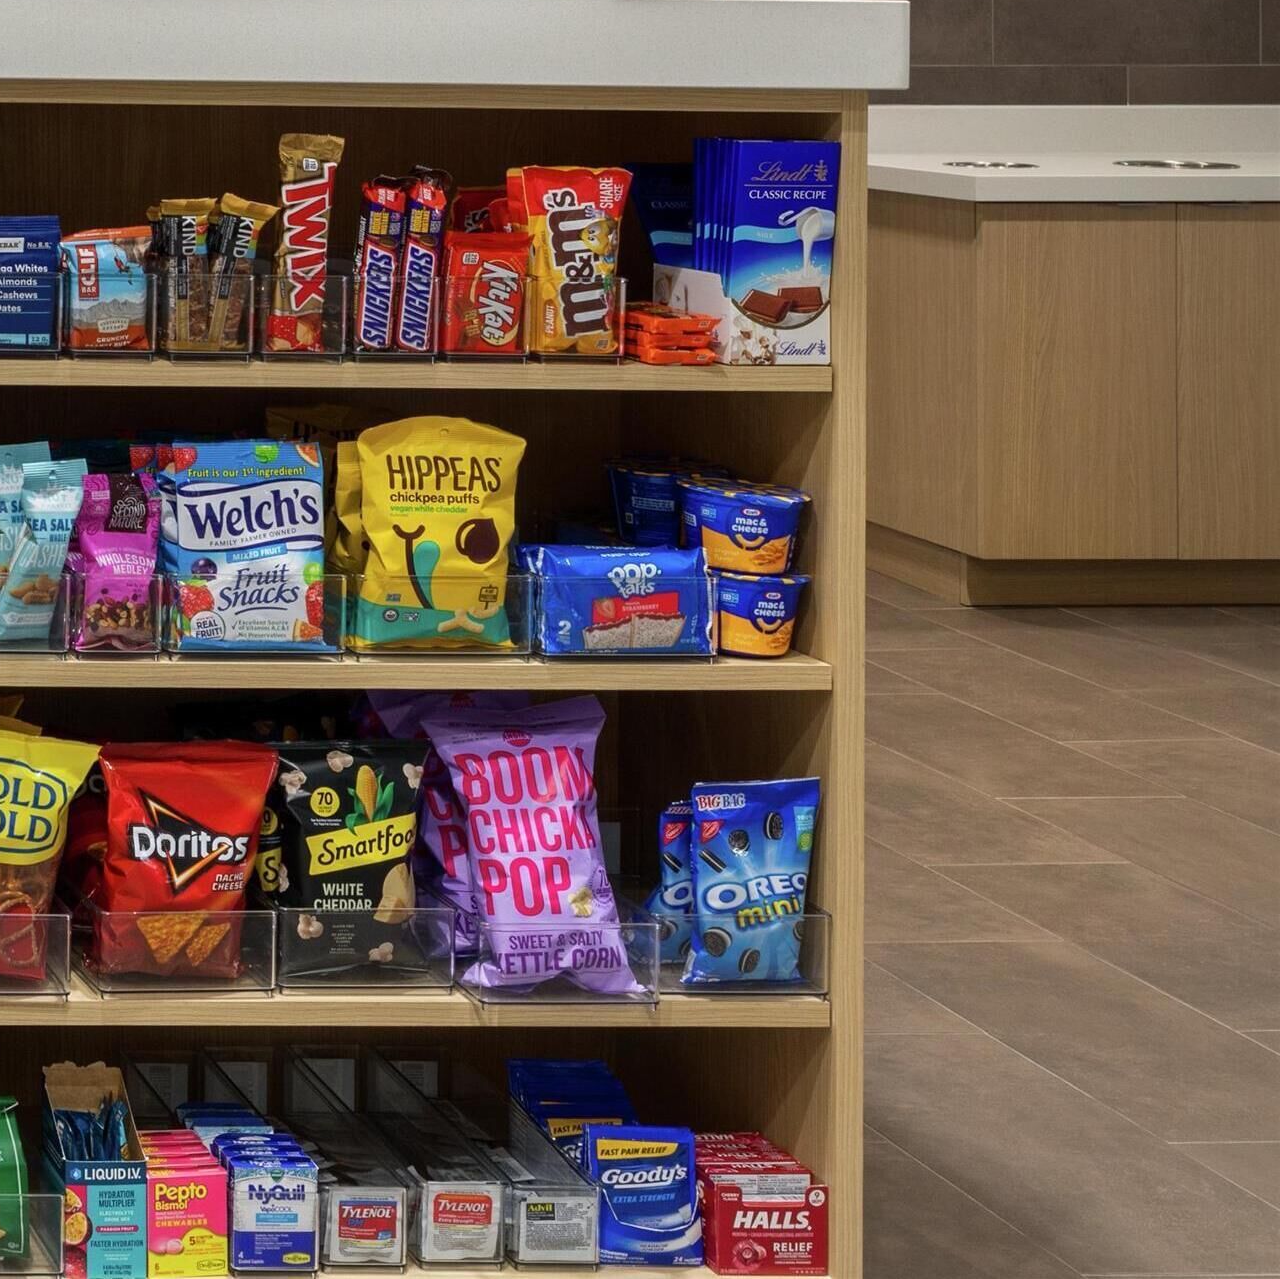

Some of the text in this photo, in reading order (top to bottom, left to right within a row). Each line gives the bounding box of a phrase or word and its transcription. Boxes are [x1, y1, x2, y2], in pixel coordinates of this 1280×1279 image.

[752, 161, 814, 183] Lindt
[749, 189, 827, 200] CLASSIC RECIPE
[182, 216, 197, 256] KIND
[233, 216, 255, 258] KIND
[281, 162, 337, 311] TWIX
[16, 264, 48, 272] Whites
[80, 248, 95, 286] CLIF
[81, 286, 97, 294] BAR
[362, 249, 393, 347] SNICKERS
[400, 245, 434, 352] SNICKERS
[187, 468, 210, 478] Fruit
[212, 468, 220, 477] is
[222, 469, 239, 477] our
[256, 466, 306, 478] ingredient!
[386, 455, 502, 493] HIPPEAS
[390, 491, 480, 506] chickpea puffs
[113, 502, 146, 518] SECOND
[184, 488, 320, 539] Welch's
[390, 504, 469, 514] vegan white cheddar
[28, 519, 76, 531] SEA SALT
[109, 515, 143, 529] NATURE
[735, 517, 767, 526] mac &
[209, 527, 297, 547] FAMILY FARMER OWNED
[95, 554, 155, 568] WHOLESOM
[232, 547, 282, 562] MIXED FRUIT
[235, 563, 290, 590] Fruit
[619, 581, 654, 598] tarts
[217, 582, 300, 613] Snacks
[757, 601, 785, 609] mac &
[622, 603, 660, 612] STRAWBERRY
[196, 620, 217, 631] REAL
[195, 629, 222, 639] FRUIT!
[453, 746, 596, 805] BOOM
[696, 793, 745, 810] BIG BAG
[470, 806, 597, 854] CHICKA
[132, 825, 249, 862] Doritos
[317, 823, 415, 866] Smartfoo
[322, 883, 364, 897] WHITE
[478, 857, 572, 917] POP
[706, 873, 807, 910] OREO
[314, 899, 372, 913] CHEDDAR
[737, 895, 801, 927] mini
[509, 930, 603, 950] SWEET & SALTY
[496, 945, 622, 974] KETTLE CORN
[84, 1168, 141, 1181] LIQUID I.V.
[602, 1166, 688, 1186] Goody's
[98, 1190, 135, 1199] HYDRATION
[154, 1183, 207, 1203] Pepto
[248, 1184, 305, 1204] NyQuil
[613, 1193, 676, 1204] EXTRA STRENGTH
[98, 1199, 135, 1208] MULTIPLIER
[155, 1201, 188, 1210] Bismol
[438, 1199, 488, 1212] TYLENOL
[527, 1203, 553, 1212] Advil
[341, 1206, 392, 1218] TYLENOL
[156, 1218, 208, 1227] CHEWABLES
[773, 1242, 813, 1253] RELIEF
